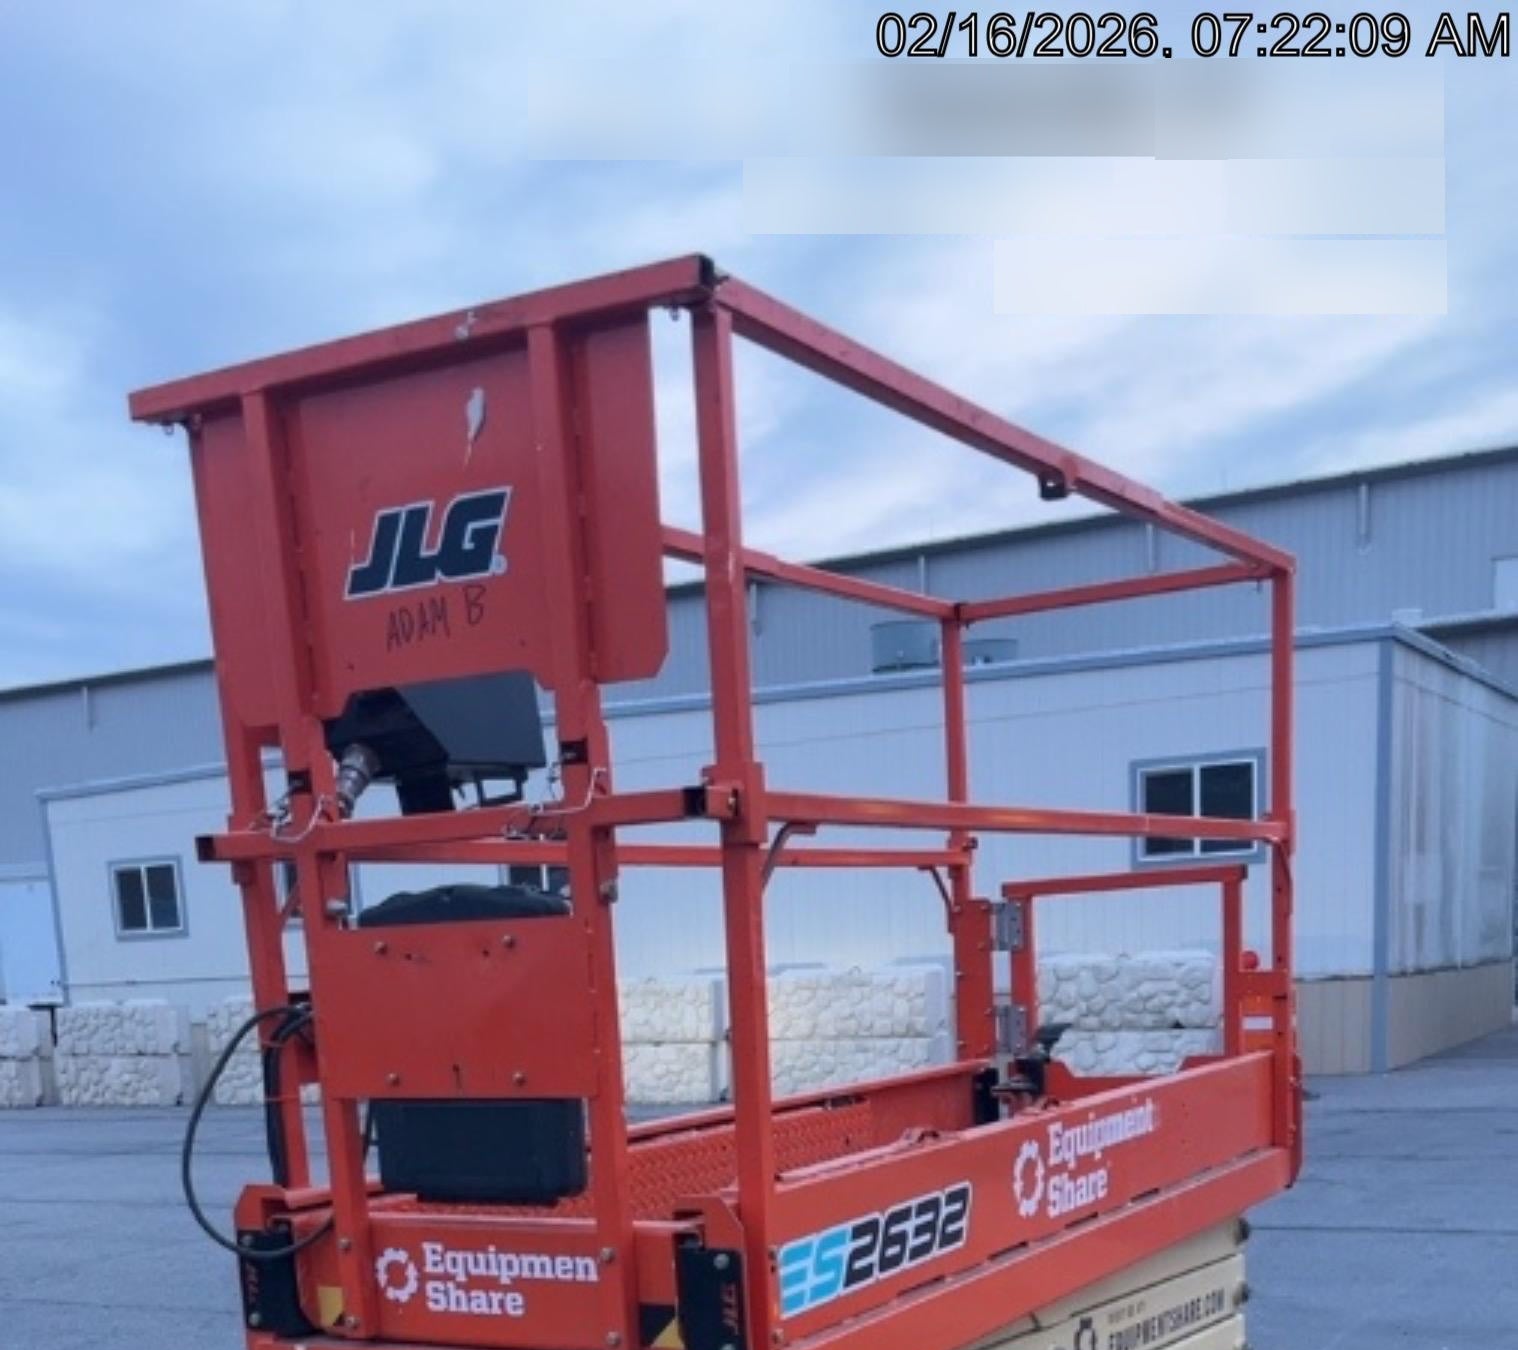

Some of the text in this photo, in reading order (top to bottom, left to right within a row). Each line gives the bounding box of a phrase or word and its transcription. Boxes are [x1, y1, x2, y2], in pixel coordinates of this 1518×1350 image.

[343, 486, 512, 600] JLG
[386, 584, 486, 652] ADAM B
[1046, 1097, 1154, 1169] Equipment
[1047, 1168, 1109, 1218] Share
[422, 1241, 600, 1284] Equipmen
[778, 1181, 972, 1320] ES2632
[426, 1280, 525, 1316] Share
